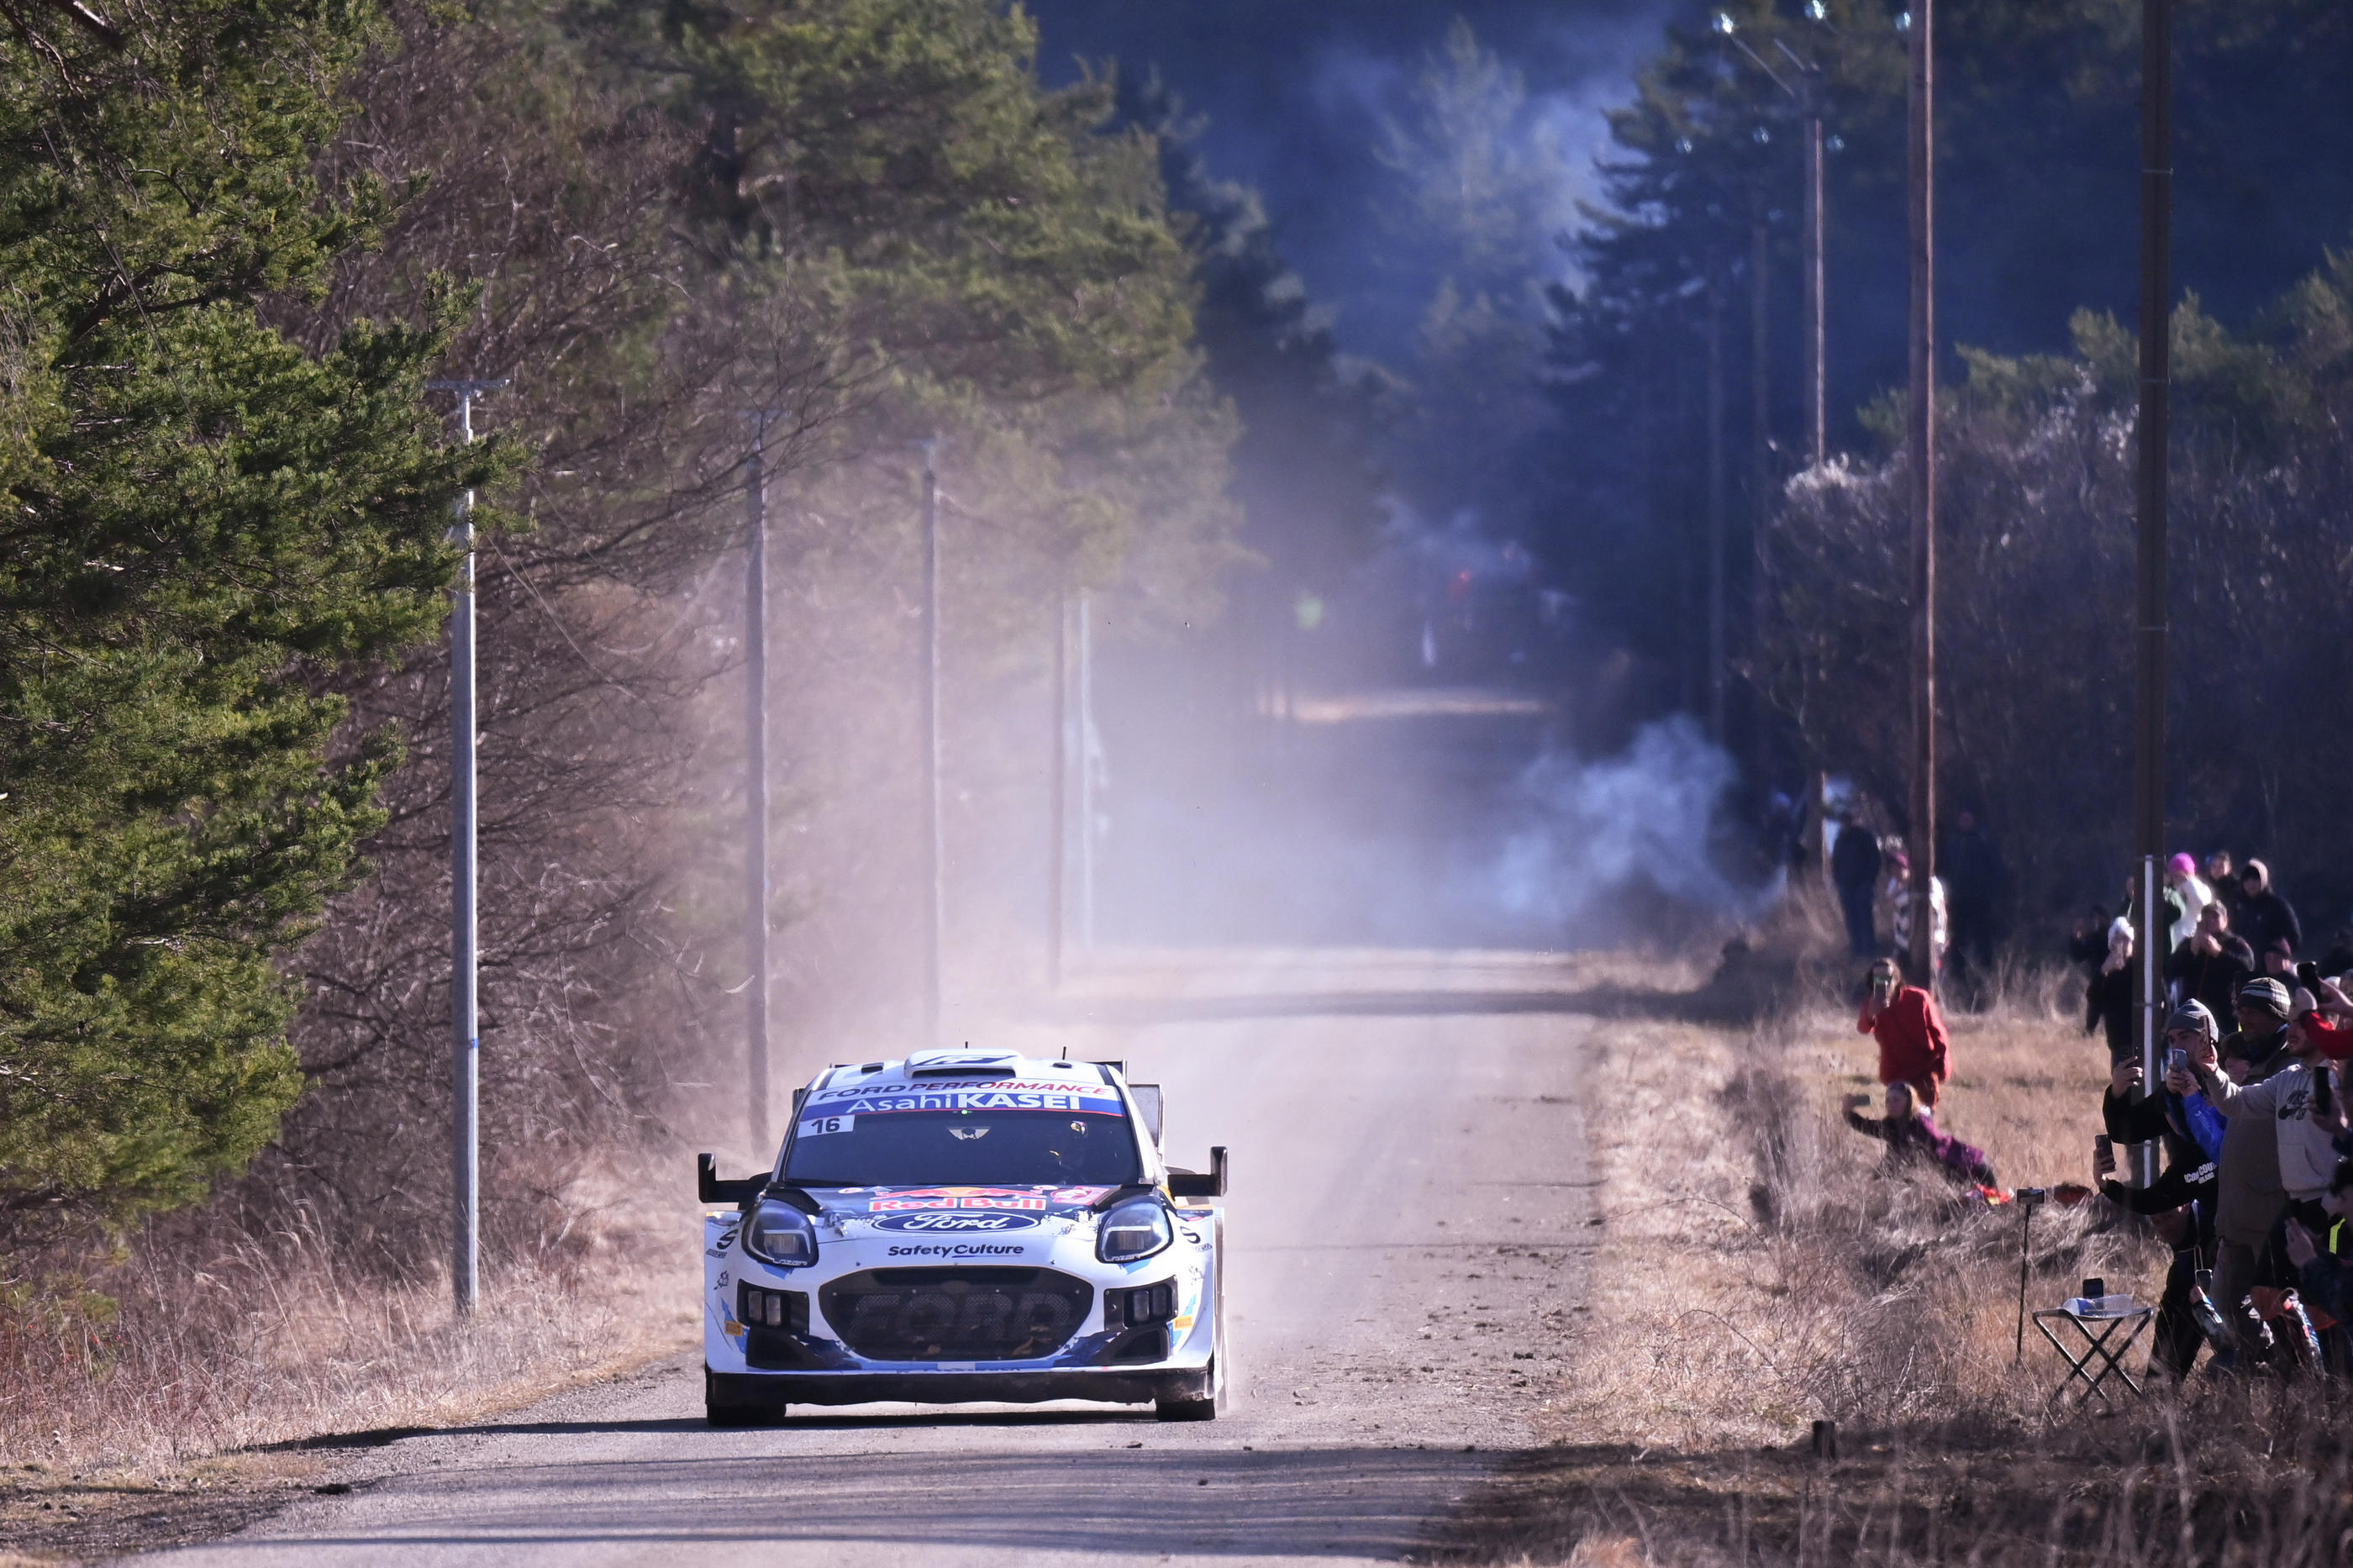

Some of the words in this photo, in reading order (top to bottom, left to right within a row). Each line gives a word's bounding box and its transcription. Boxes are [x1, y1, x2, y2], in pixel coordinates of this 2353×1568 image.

[819, 1085, 906, 1101] FORD
[908, 1081, 1109, 1095] PERFORMANCE
[845, 1094, 951, 1113] Asahi
[958, 1093, 1081, 1110] KASEI
[811, 1117, 840, 1134] 16
[869, 1198, 957, 1212] Red
[960, 1198, 1046, 1210] Bull
[903, 1213, 1011, 1230] Ford
[887, 1244, 1024, 1259] SafetyCulture
